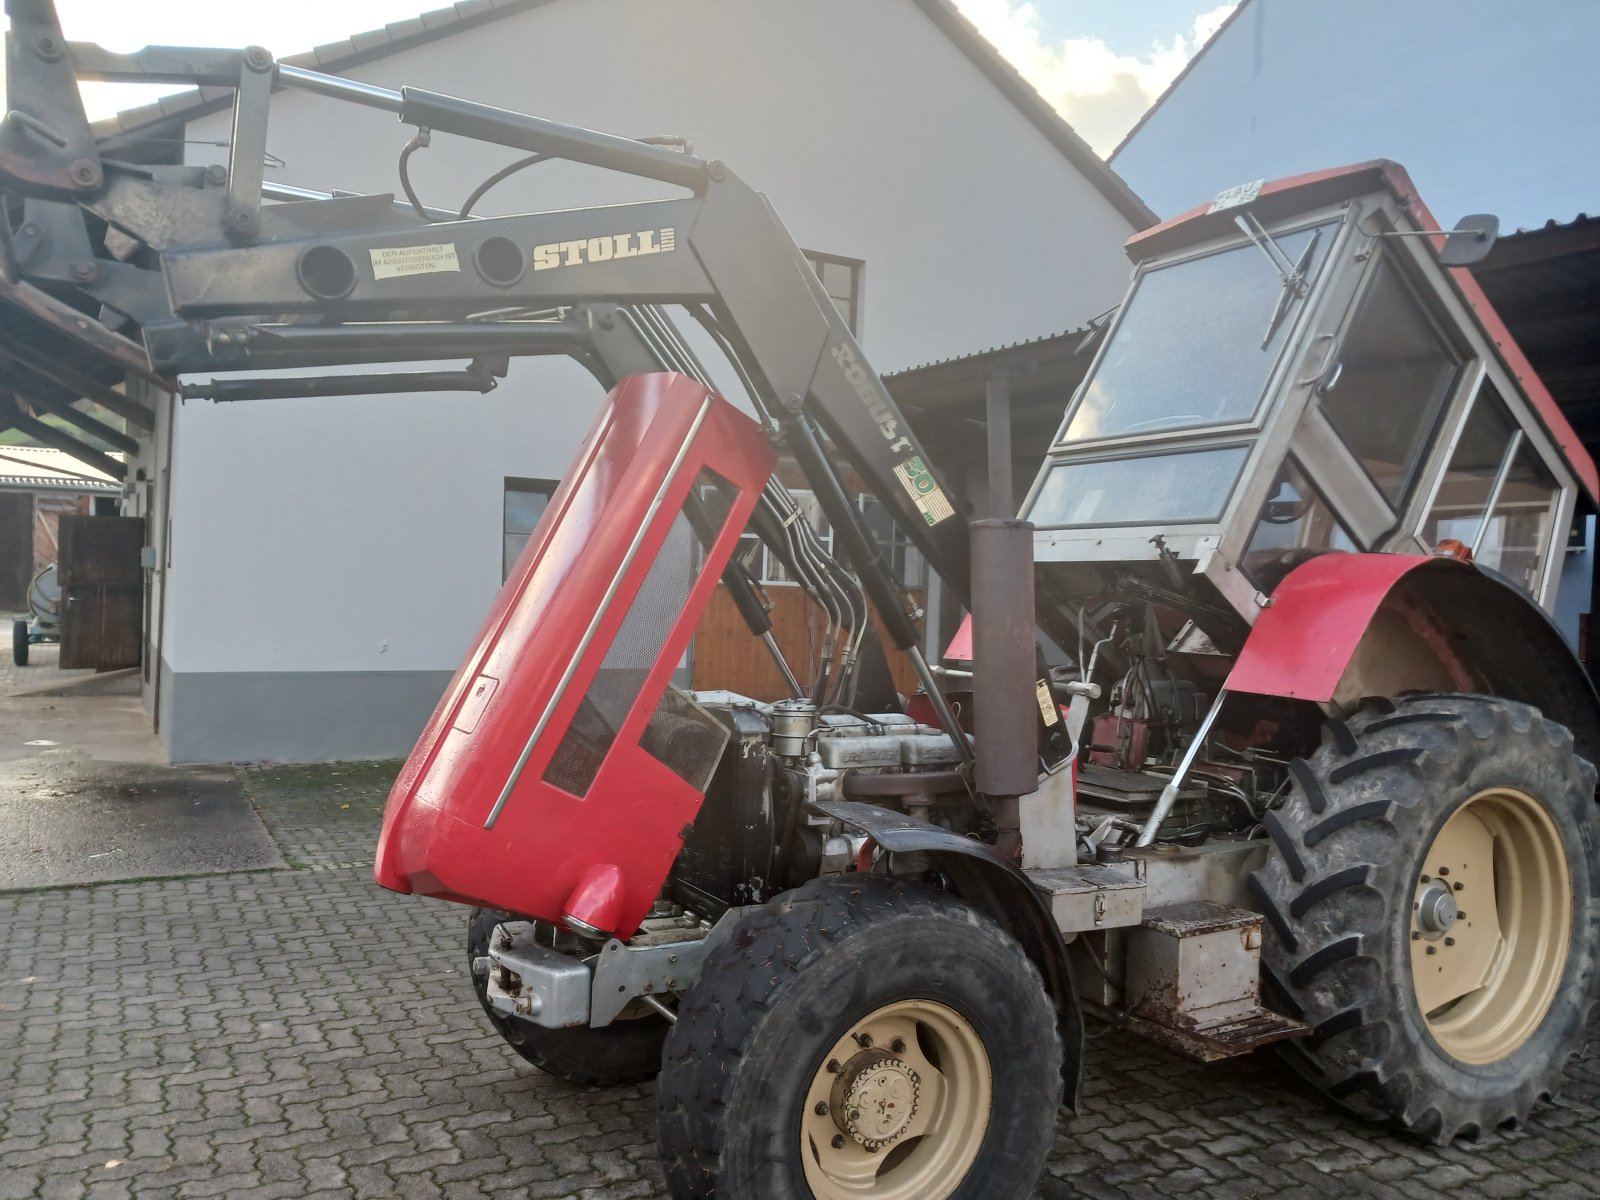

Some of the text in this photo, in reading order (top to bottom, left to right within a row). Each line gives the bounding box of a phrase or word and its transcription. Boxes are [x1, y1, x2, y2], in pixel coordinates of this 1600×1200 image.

[382, 246, 443, 258] DER AUFENTHALT
[532, 229, 661, 271] STOLL
[383, 254, 444, 265] ARBEITSBEREICH
[445, 252, 456, 260] IST
[830, 342, 936, 495] ROBUST 30
[924, 511, 935, 525] HD
